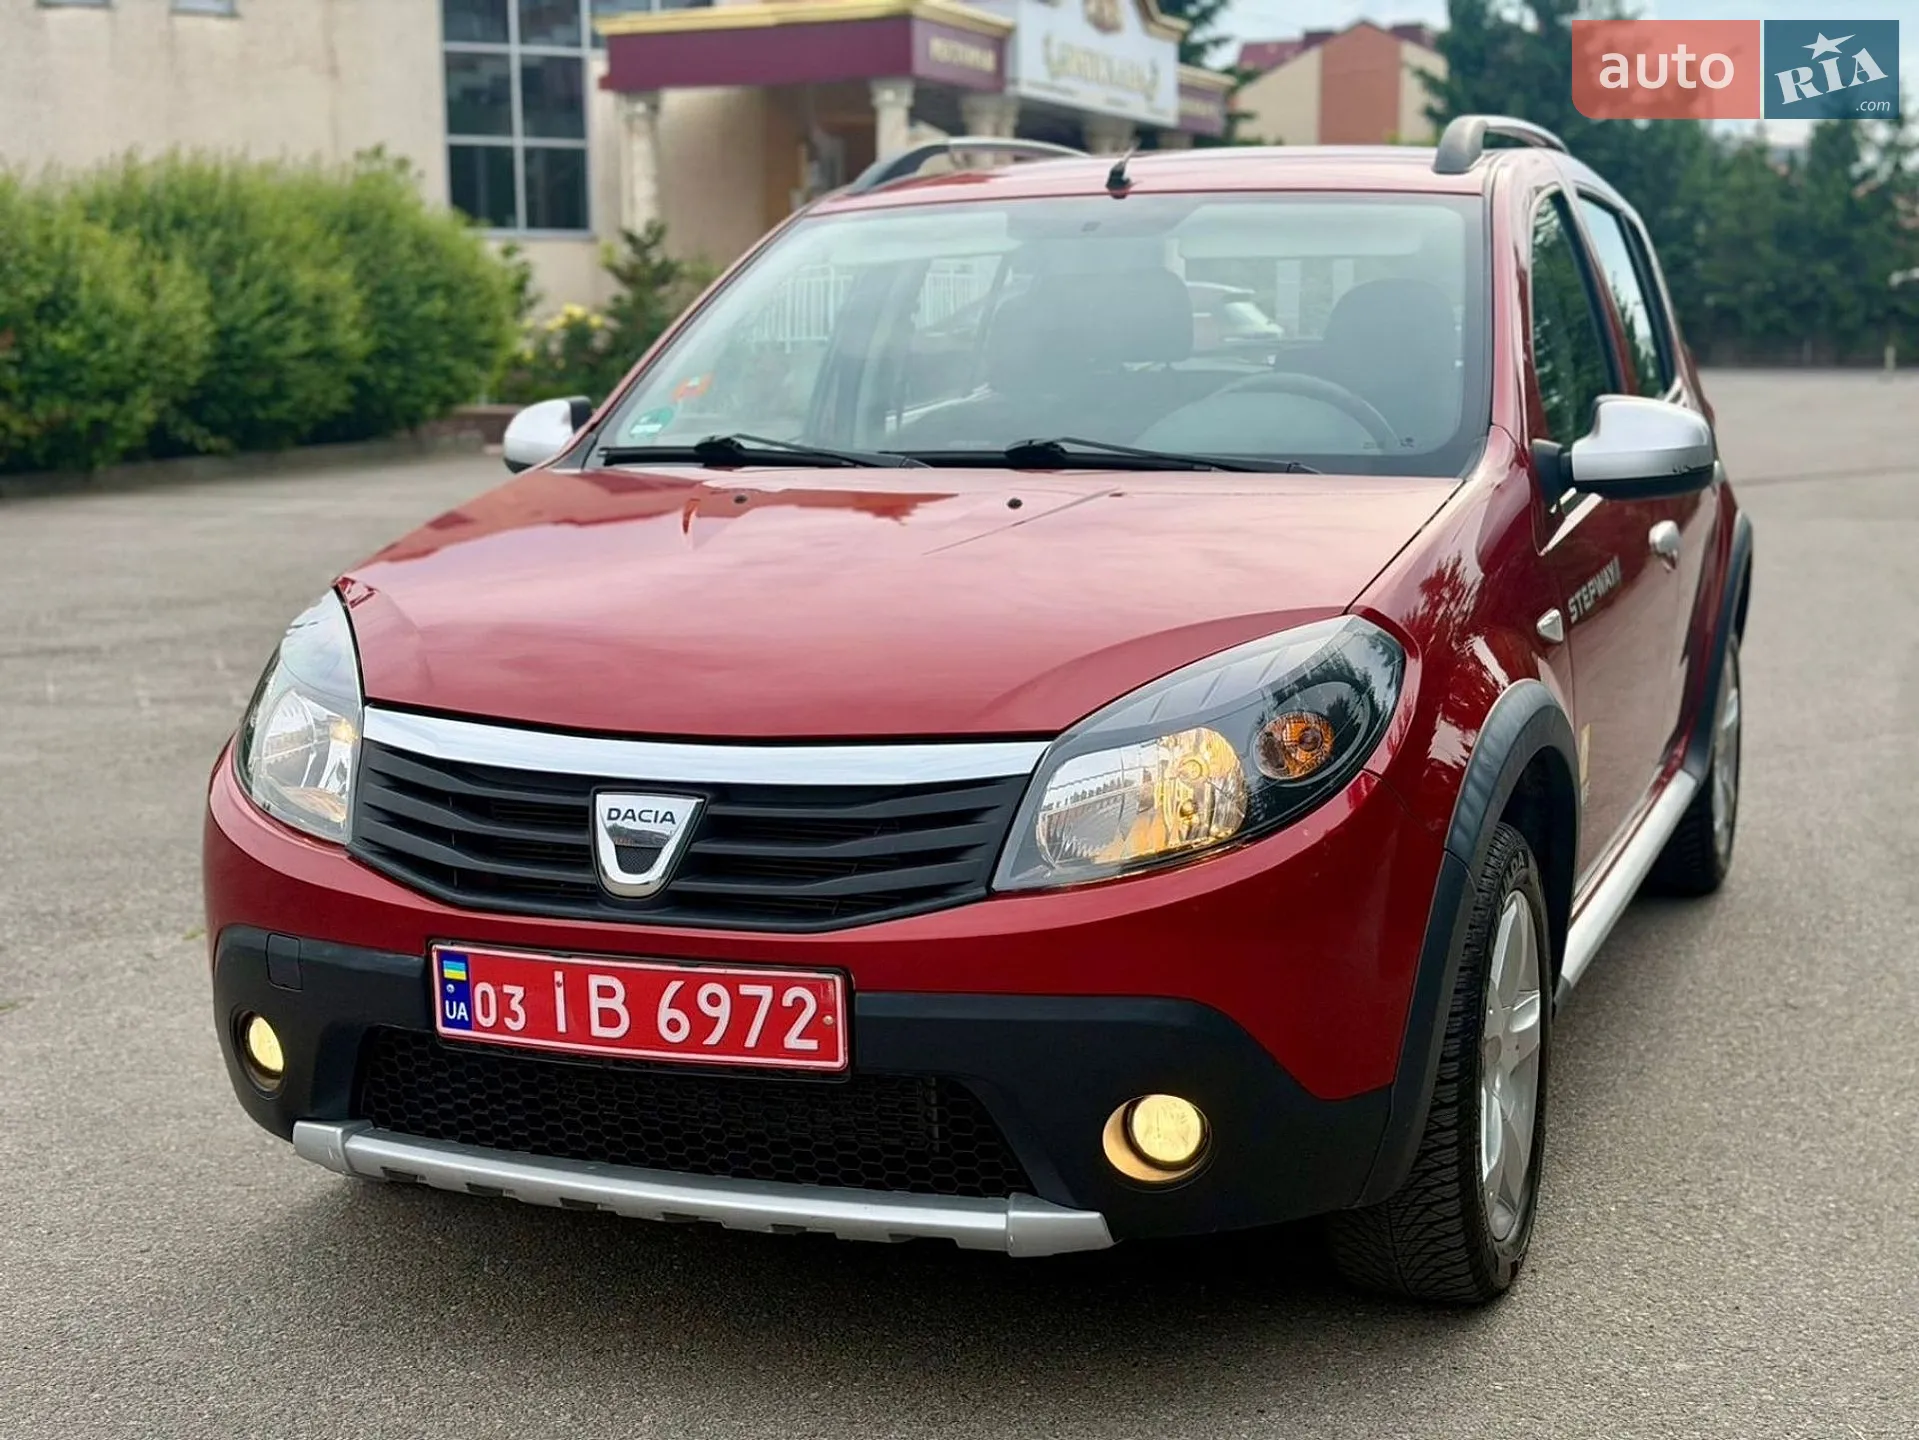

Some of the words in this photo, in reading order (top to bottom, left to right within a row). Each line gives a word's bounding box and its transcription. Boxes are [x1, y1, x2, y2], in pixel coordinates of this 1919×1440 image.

[1567, 554, 1622, 625] STEPWAY
[606, 807, 677, 825] DACIA
[445, 999, 470, 1022] UA
[473, 981, 527, 1033] 03
[656, 980, 819, 1052] 6972
